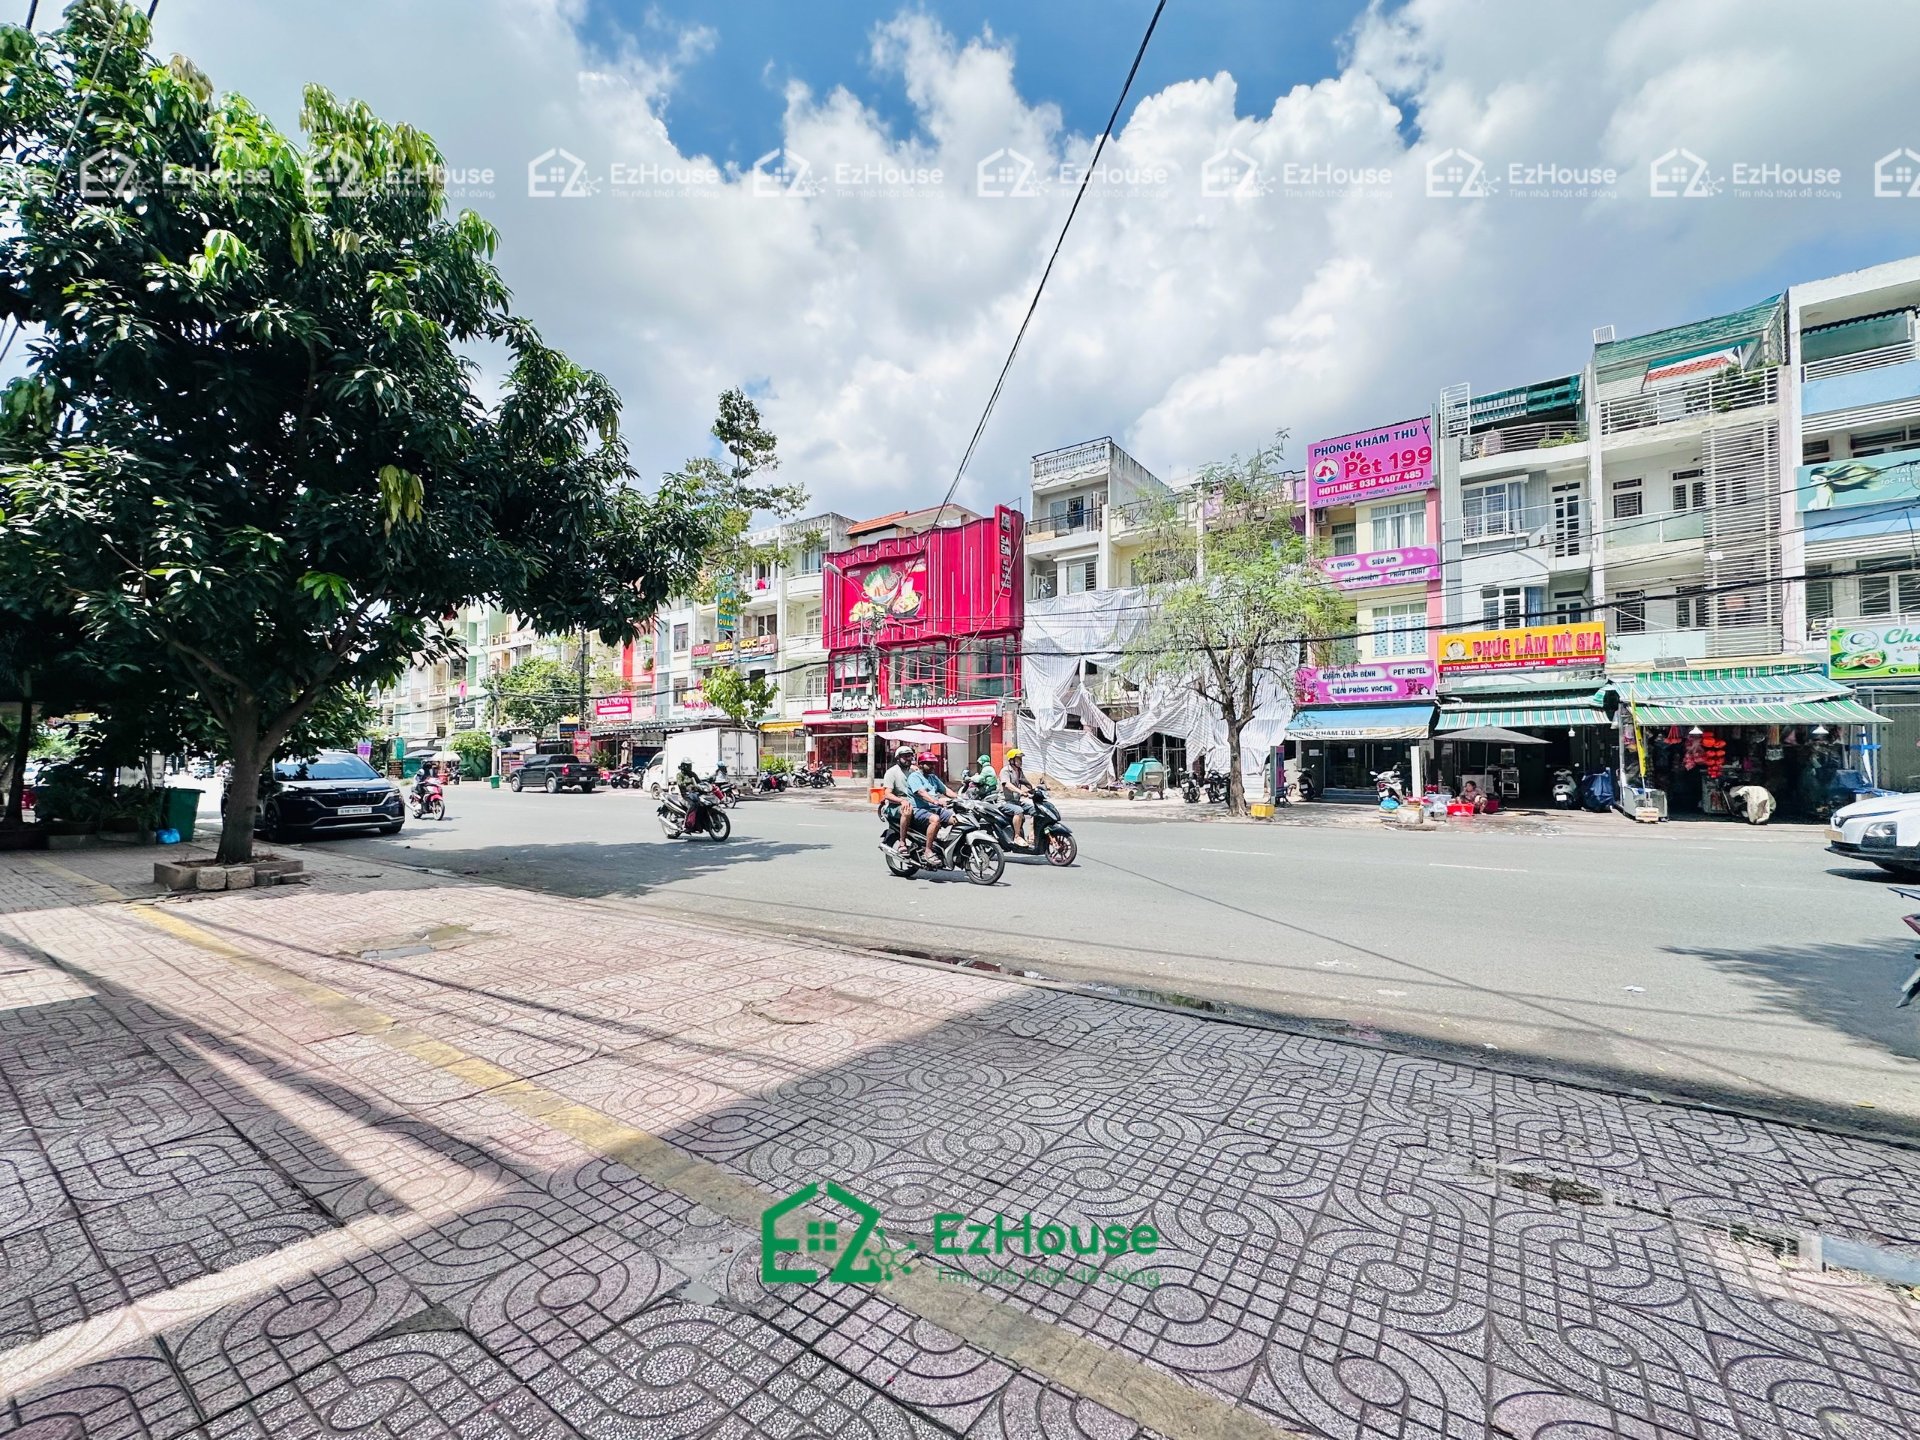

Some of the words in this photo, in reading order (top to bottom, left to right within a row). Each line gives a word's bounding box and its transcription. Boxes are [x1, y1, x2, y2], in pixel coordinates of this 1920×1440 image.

[1314, 443, 1351, 457] PHÒNG
[1355, 434, 1389, 448] KHÁM
[1394, 426, 1418, 440] THÚ
[1423, 425, 1429, 434] Y
[1344, 459, 1382, 479] Pet
[1389, 446, 1432, 470] 199
[1319, 482, 1357, 496] HOTLINE:
[1360, 480, 1376, 489] 038
[1379, 474, 1401, 484] 4407
[1404, 470, 1422, 480] 485
[1515, 633, 1548, 657] LÂM
[1553, 630, 1572, 654] MÌ
[1576, 632, 1602, 652] GIA
